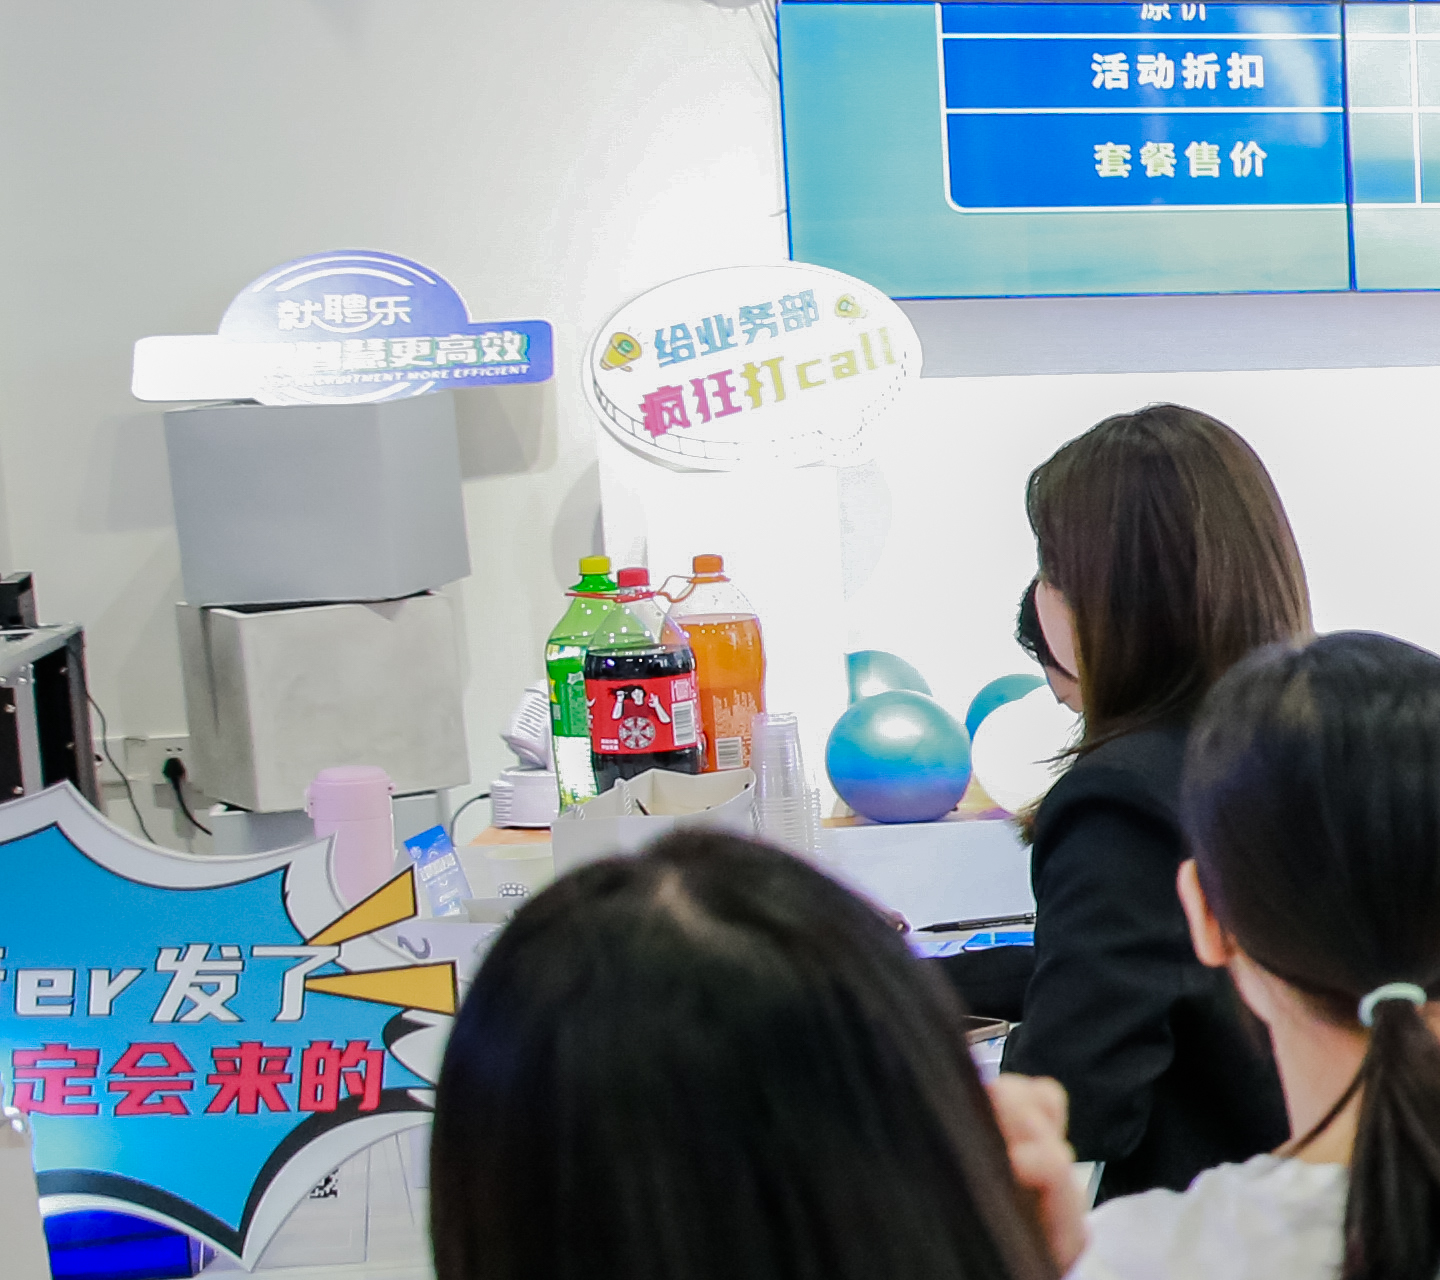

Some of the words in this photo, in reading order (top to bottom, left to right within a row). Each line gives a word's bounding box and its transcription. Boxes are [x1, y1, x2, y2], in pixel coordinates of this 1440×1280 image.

[1091, 51, 1265, 90] 活动折扣
[1093, 140, 1268, 179] 套餐售价
[277, 293, 412, 333] 就聘乐
[654, 289, 819, 368] 给业务部
[453, 364, 531, 379] EFFICIENT
[638, 326, 897, 438] 疯狂打call
[12, 1040, 385, 1117] 定会来的
